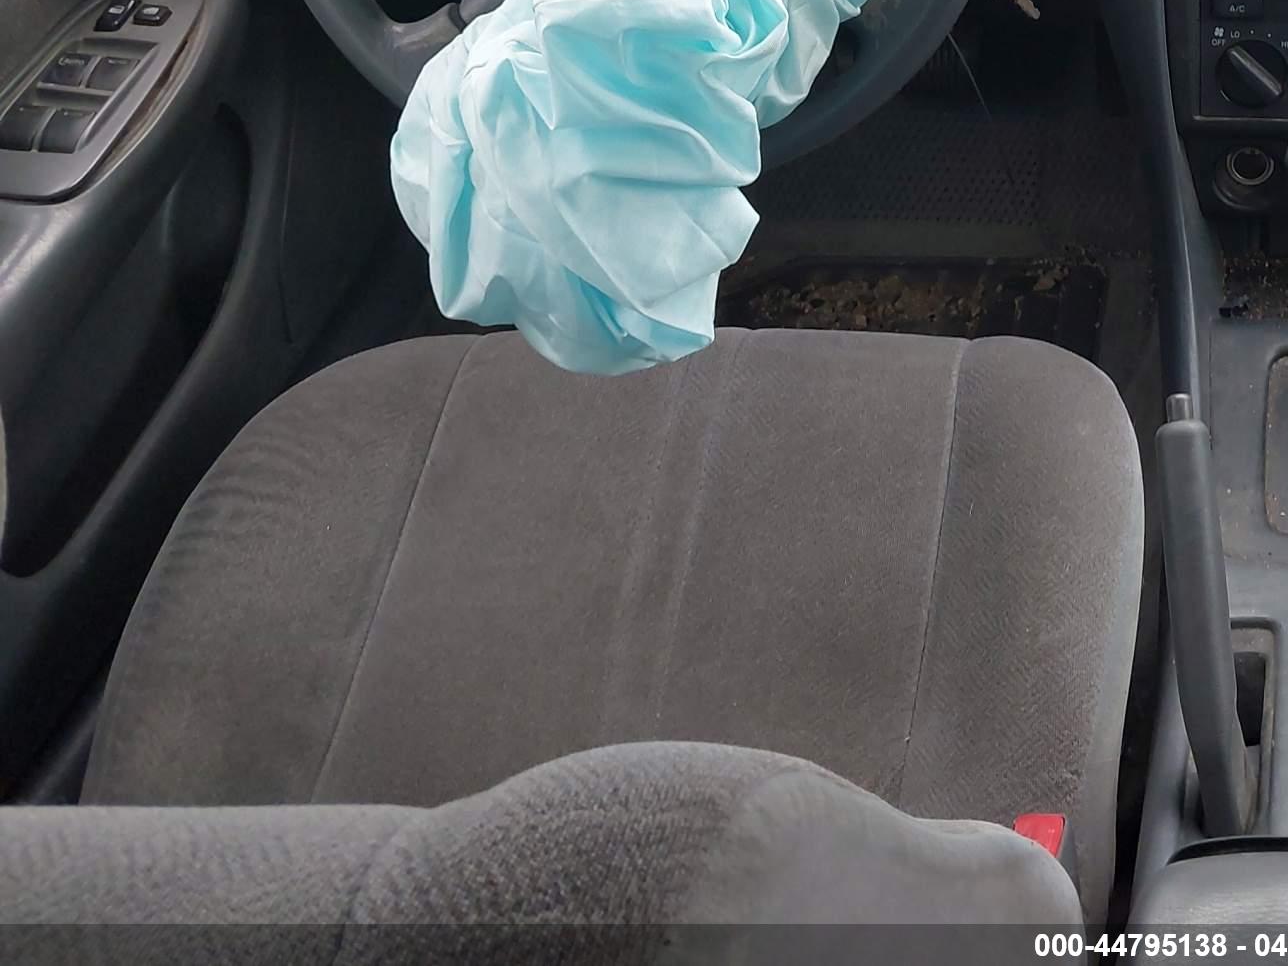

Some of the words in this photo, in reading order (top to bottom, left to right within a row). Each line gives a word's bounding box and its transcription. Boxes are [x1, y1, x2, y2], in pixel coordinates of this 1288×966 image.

[1229, 4, 1246, 13] A/C
[1230, 30, 1241, 39] LO
[1211, 38, 1225, 47] OFF
